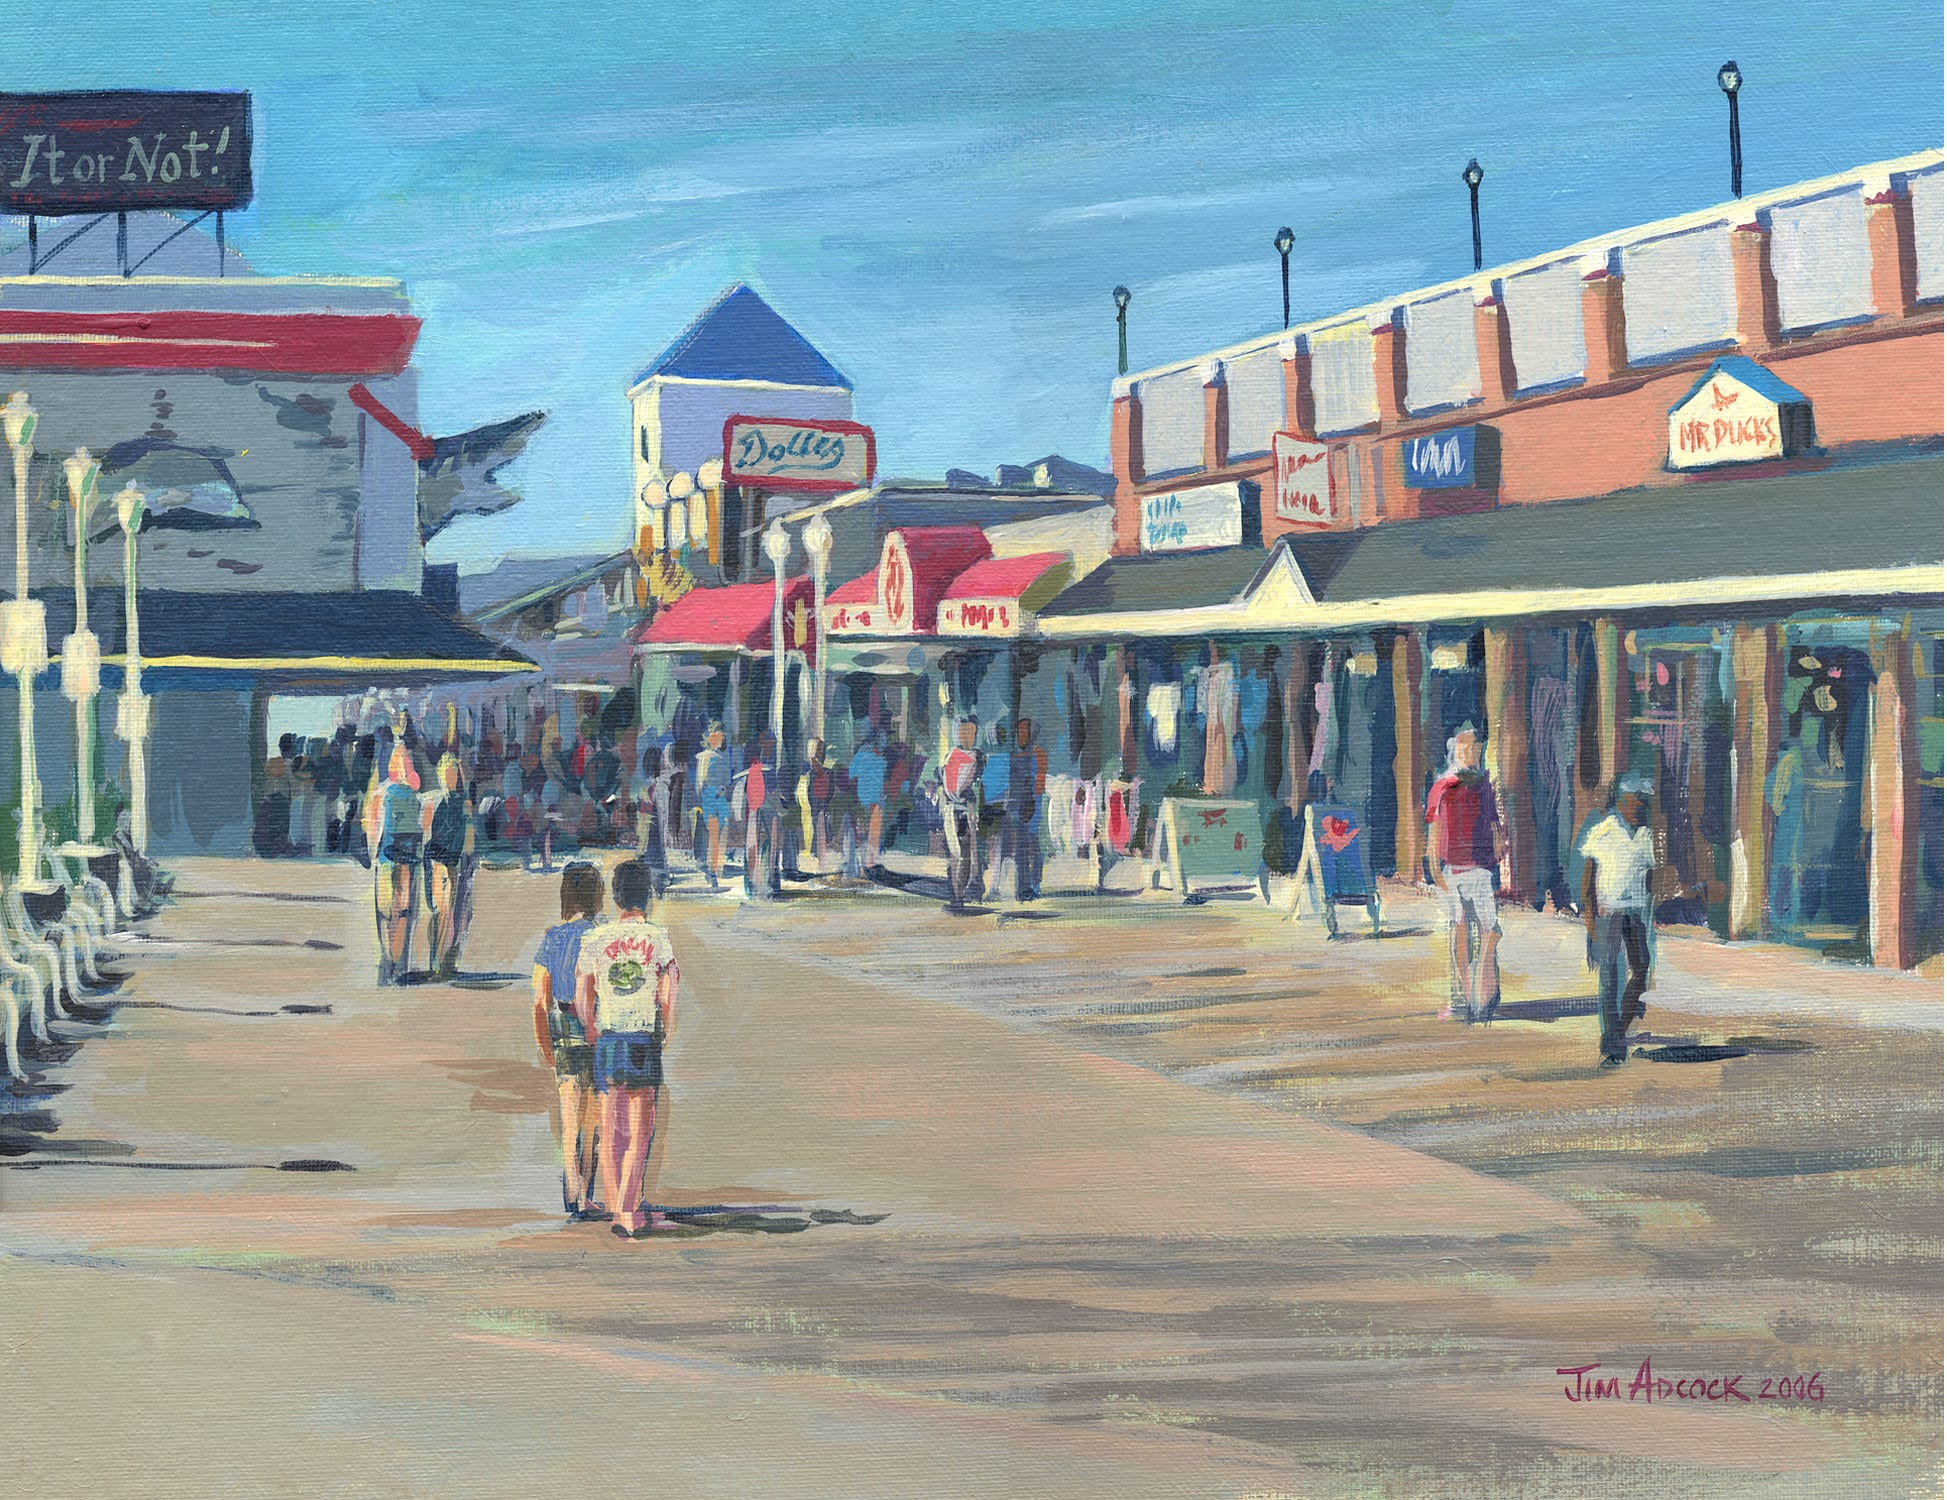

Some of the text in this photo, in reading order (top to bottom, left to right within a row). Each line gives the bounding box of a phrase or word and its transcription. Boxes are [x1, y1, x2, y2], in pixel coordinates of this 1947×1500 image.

[10, 126, 230, 188] It or Not!
[1679, 415, 1777, 453] MR DUCKS
